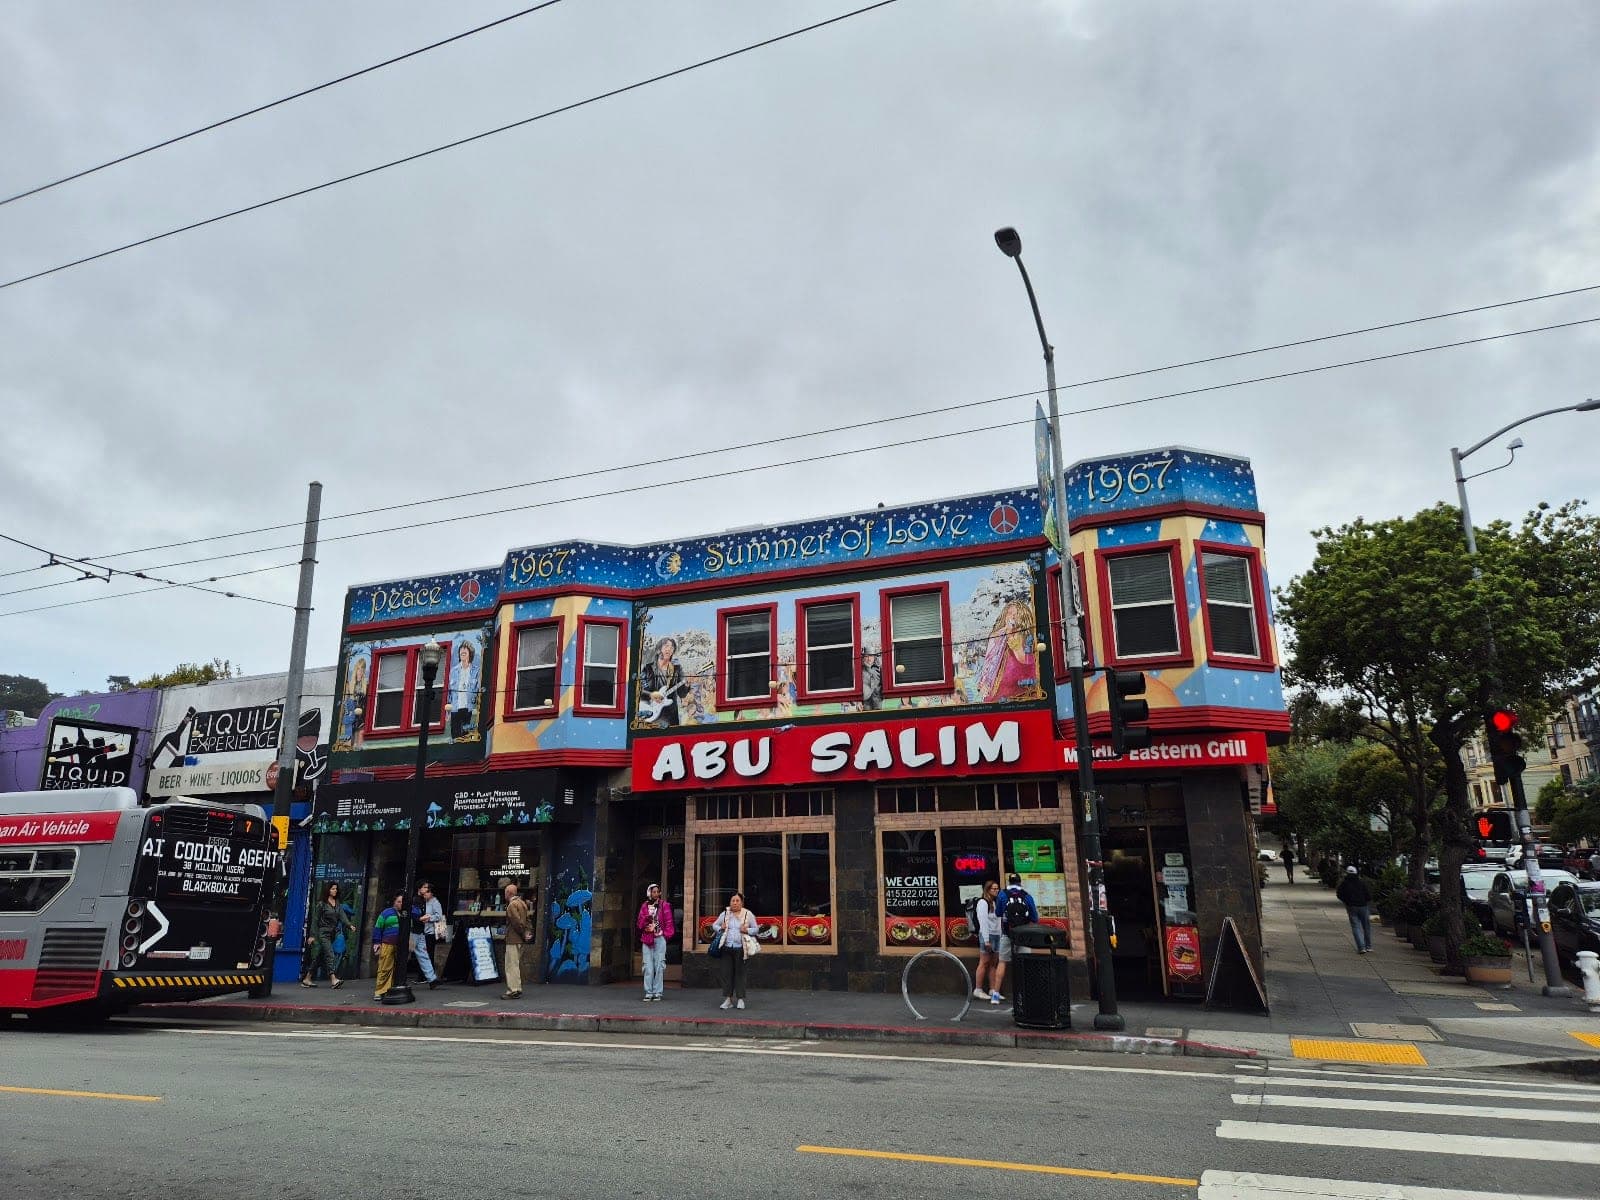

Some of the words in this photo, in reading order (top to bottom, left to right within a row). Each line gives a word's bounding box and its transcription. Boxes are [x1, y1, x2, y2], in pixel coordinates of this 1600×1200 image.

[1084, 458, 1174, 504] 1967
[703, 530, 832, 573] Summer
[840, 519, 874, 557] of
[886, 513, 970, 546] Love
[511, 549, 571, 584] 1967
[192, 706, 280, 738] LIQUID
[189, 730, 277, 754] EXPERIENCE
[651, 735, 771, 782] ABU
[810, 720, 1022, 774] SALIM
[1207, 739, 1247, 758] Grill
[47, 764, 125, 784] LIQUID
[159, 775, 181, 789] BEER
[189, 772, 212, 787] WINE
[220, 769, 262, 786] LIQUORS
[17, 821, 40, 836] Air
[41, 819, 90, 836] Vehicle
[245, 820, 252, 833] 7
[142, 837, 166, 858] AI
[174, 841, 231, 864] CODING
[238, 848, 279, 868] AGENT
[194, 862, 223, 873] MILLION
[225, 865, 246, 875] USERS
[956, 856, 986, 870] OPEN
[182, 880, 240, 894] BLACKBOX.AI
[886, 877, 903, 887] WE
[904, 876, 938, 887] CATER
[886, 899, 939, 907] EZcater.com
